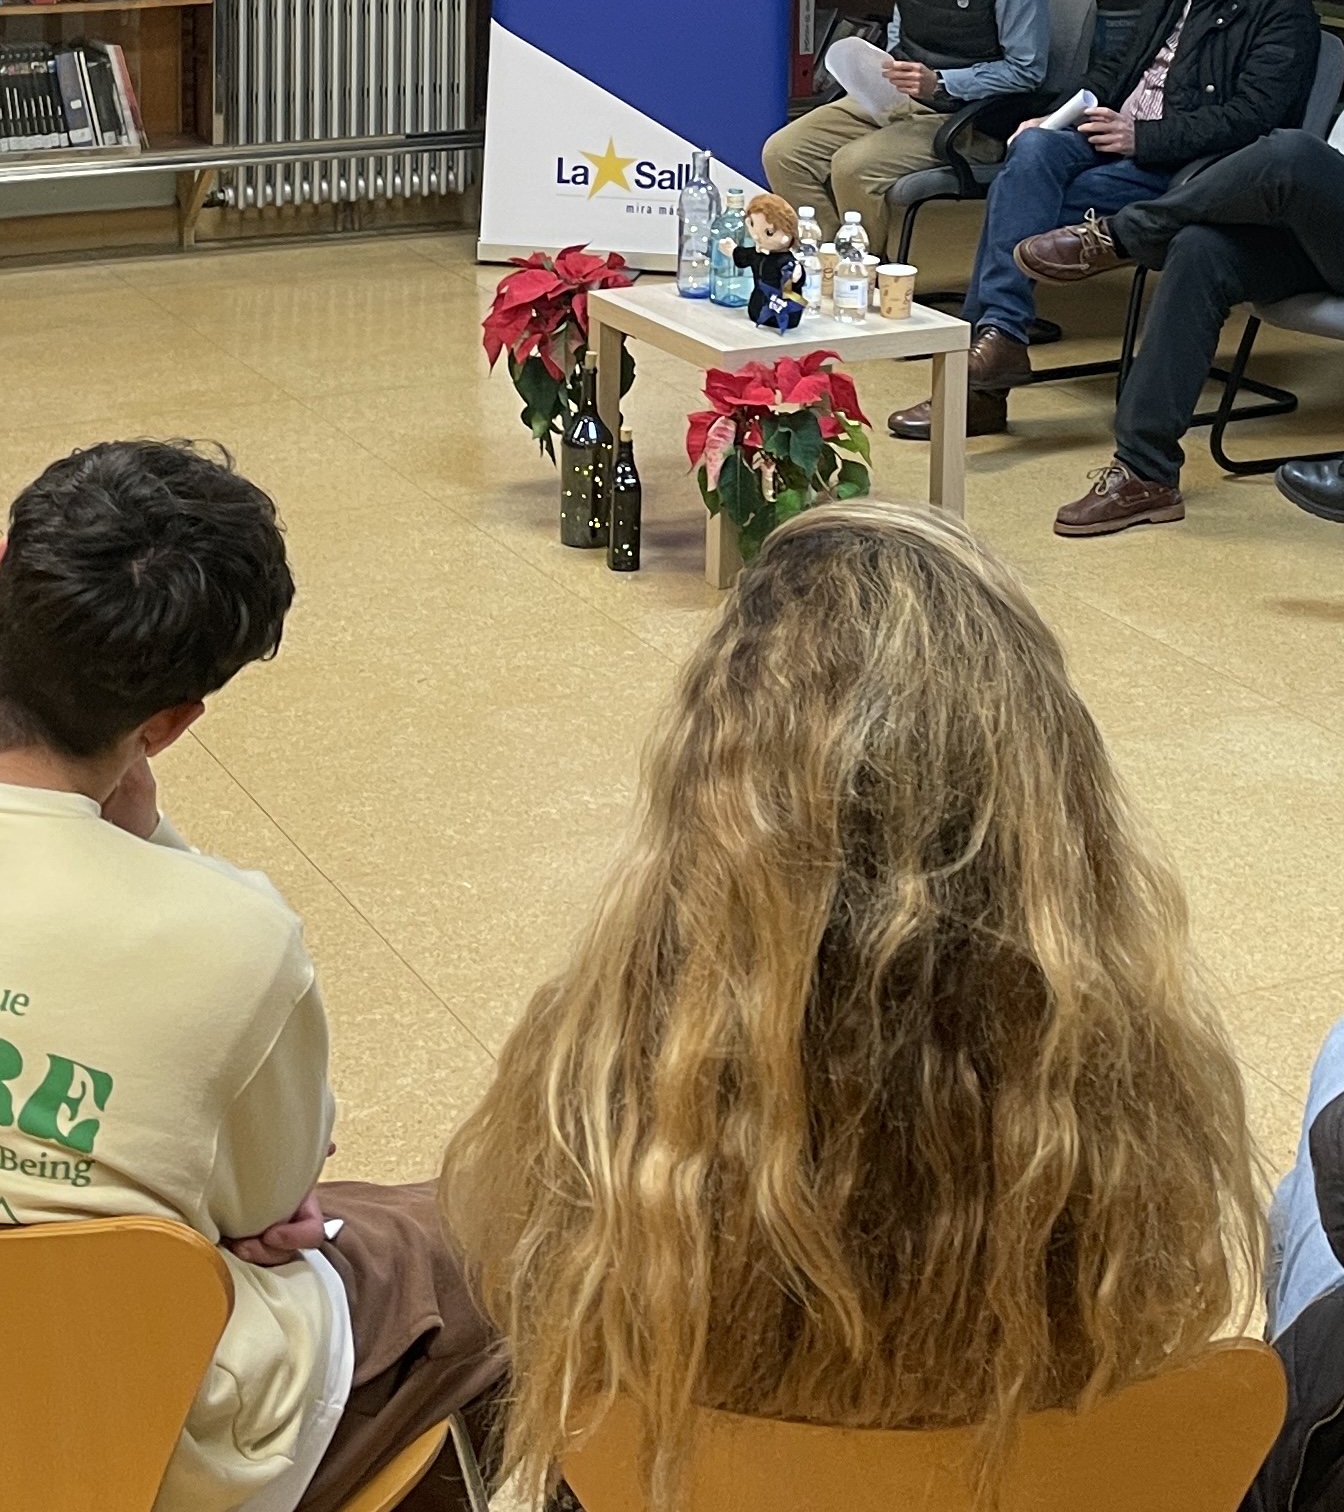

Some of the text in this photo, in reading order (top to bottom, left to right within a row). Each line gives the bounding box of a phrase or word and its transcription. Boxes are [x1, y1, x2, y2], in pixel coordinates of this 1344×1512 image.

[556, 156, 692, 191] La Sall
[625, 202, 653, 215] mira
